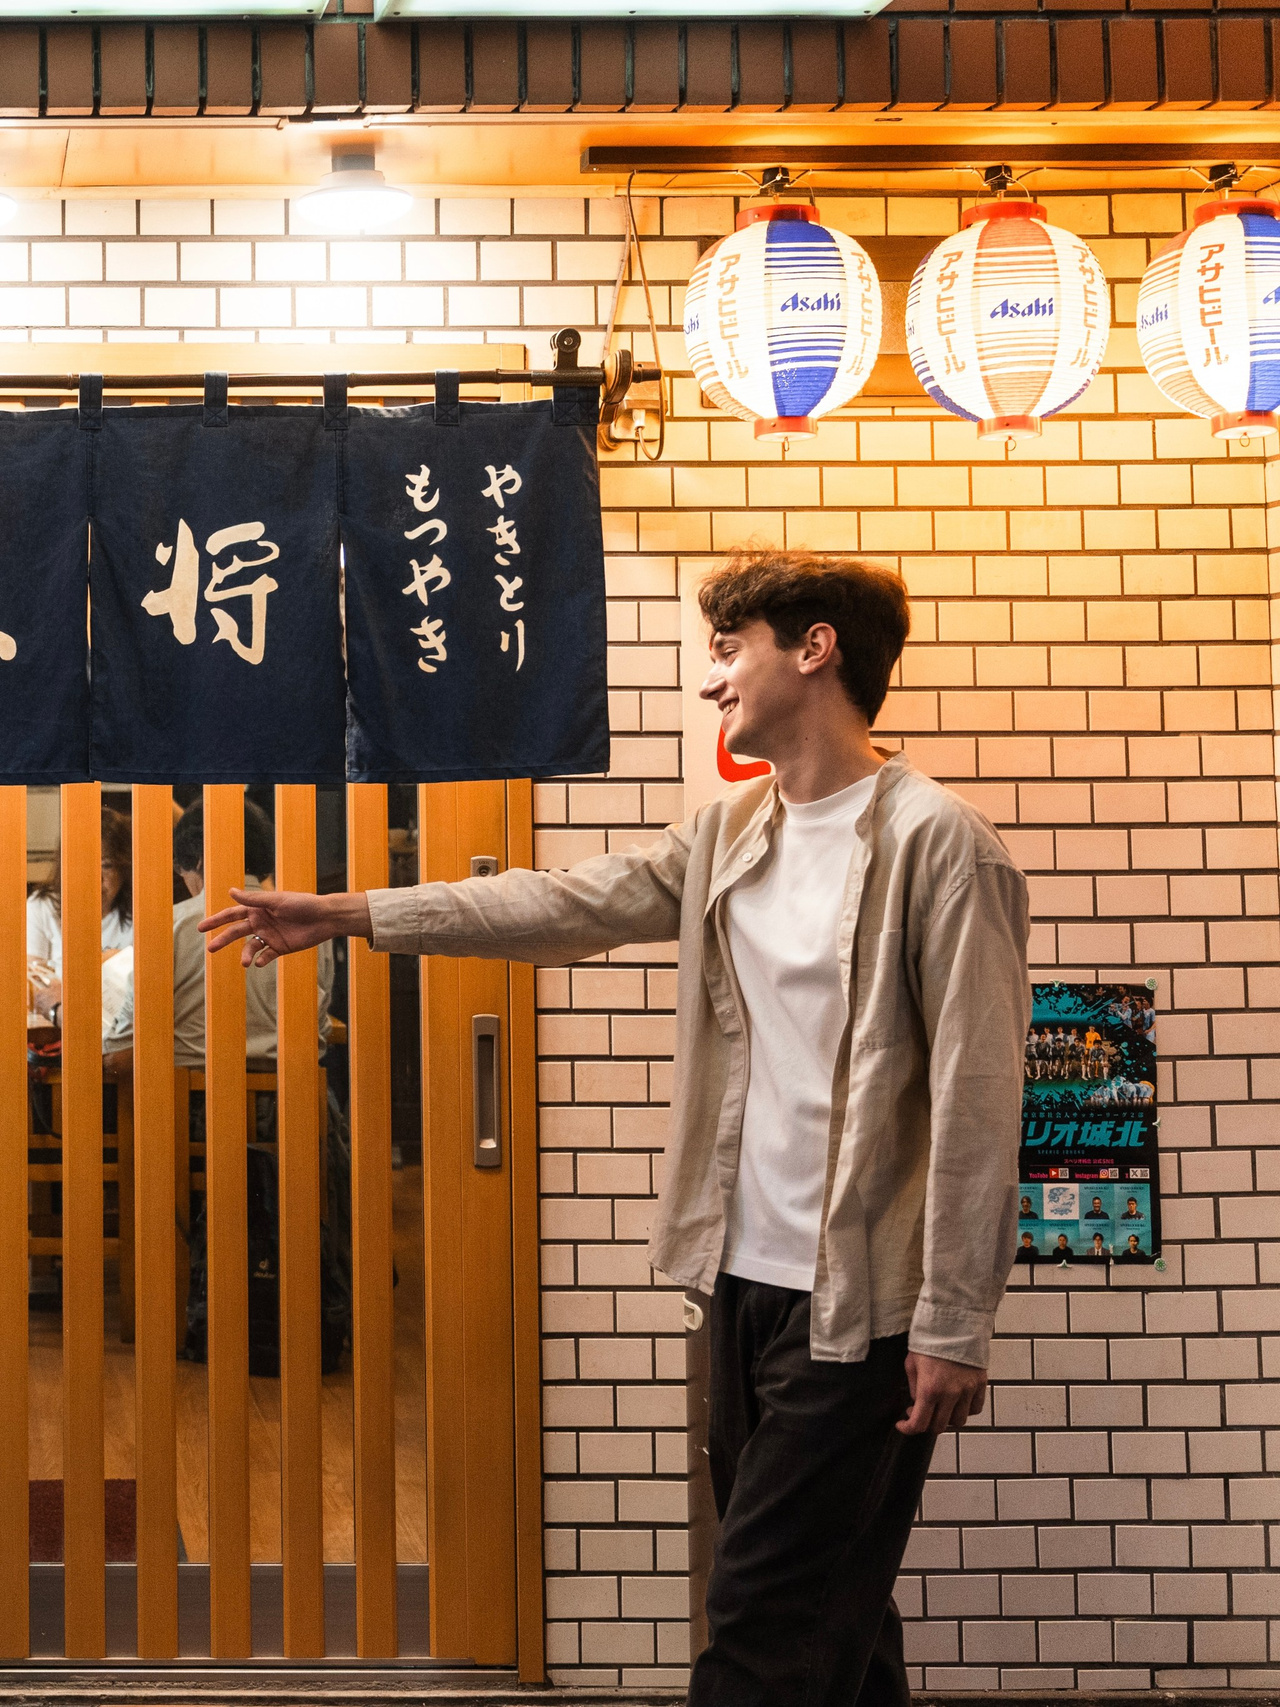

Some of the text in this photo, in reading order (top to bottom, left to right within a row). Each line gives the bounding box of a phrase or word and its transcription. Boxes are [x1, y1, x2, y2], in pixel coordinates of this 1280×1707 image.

[717, 253, 749, 379] アサヒビール
[780, 292, 841, 312] Asahi
[846, 252, 873, 376] アサヒビール
[936, 250, 966, 375] アサヒビール
[989, 297, 1054, 319] Asahi
[1070, 245, 1098, 368] アサヒビール
[1197, 243, 1230, 368] アサヒビール
[402, 464, 452, 673] もつやき
[481, 464, 525, 673] やきとり
[1020, 1121, 1148, 1147] リオ城北
